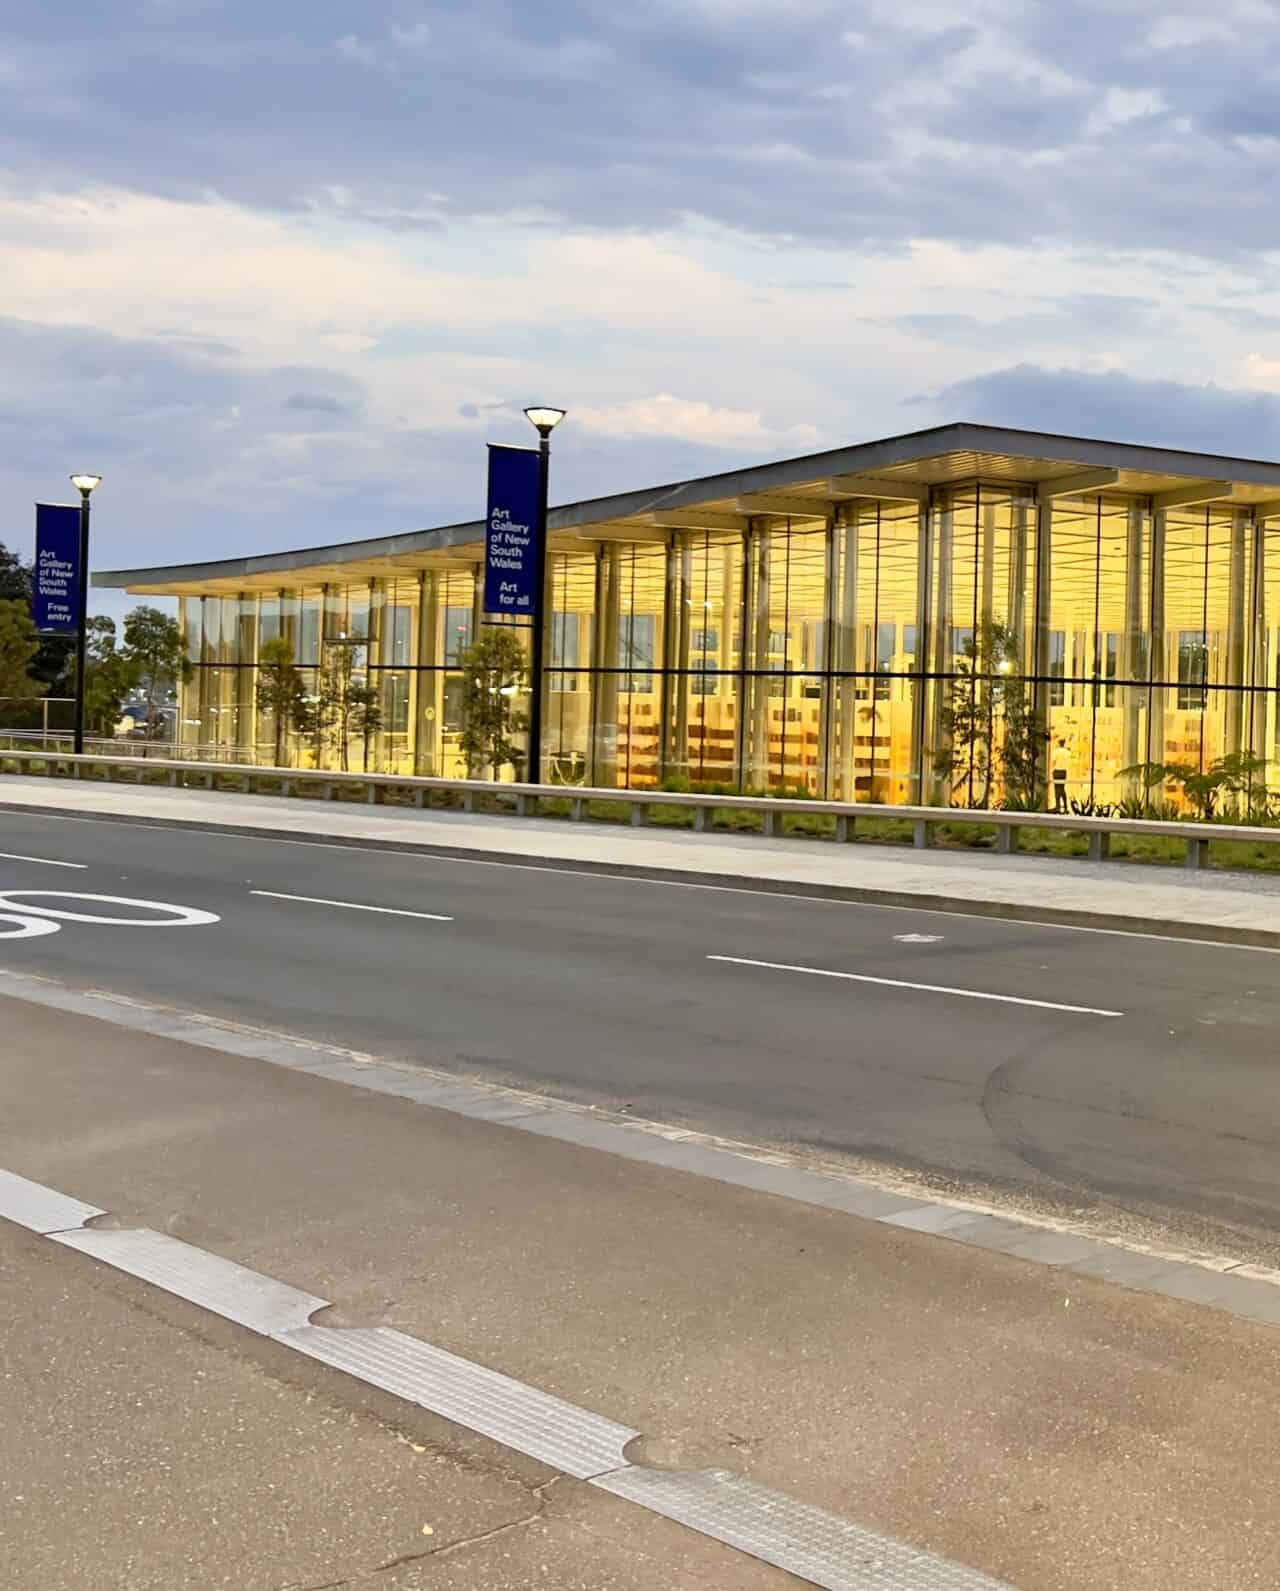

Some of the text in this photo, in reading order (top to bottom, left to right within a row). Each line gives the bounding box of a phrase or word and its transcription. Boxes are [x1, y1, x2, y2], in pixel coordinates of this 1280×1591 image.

[492, 507, 510, 519] Art
[491, 519, 529, 535] Gallery
[491, 533, 530, 546] of New
[40, 549, 56, 559] Art
[490, 544, 522, 557] South
[40, 558, 73, 570] Gallery
[489, 556, 522, 570] Wales
[40, 568, 73, 578] of New
[39, 577, 67, 587] South
[500, 581, 518, 592] Art
[39, 586, 67, 596] Wales
[499, 593, 529, 605] for all
[48, 602, 69, 612] Free
[47, 613, 72, 623] entry
